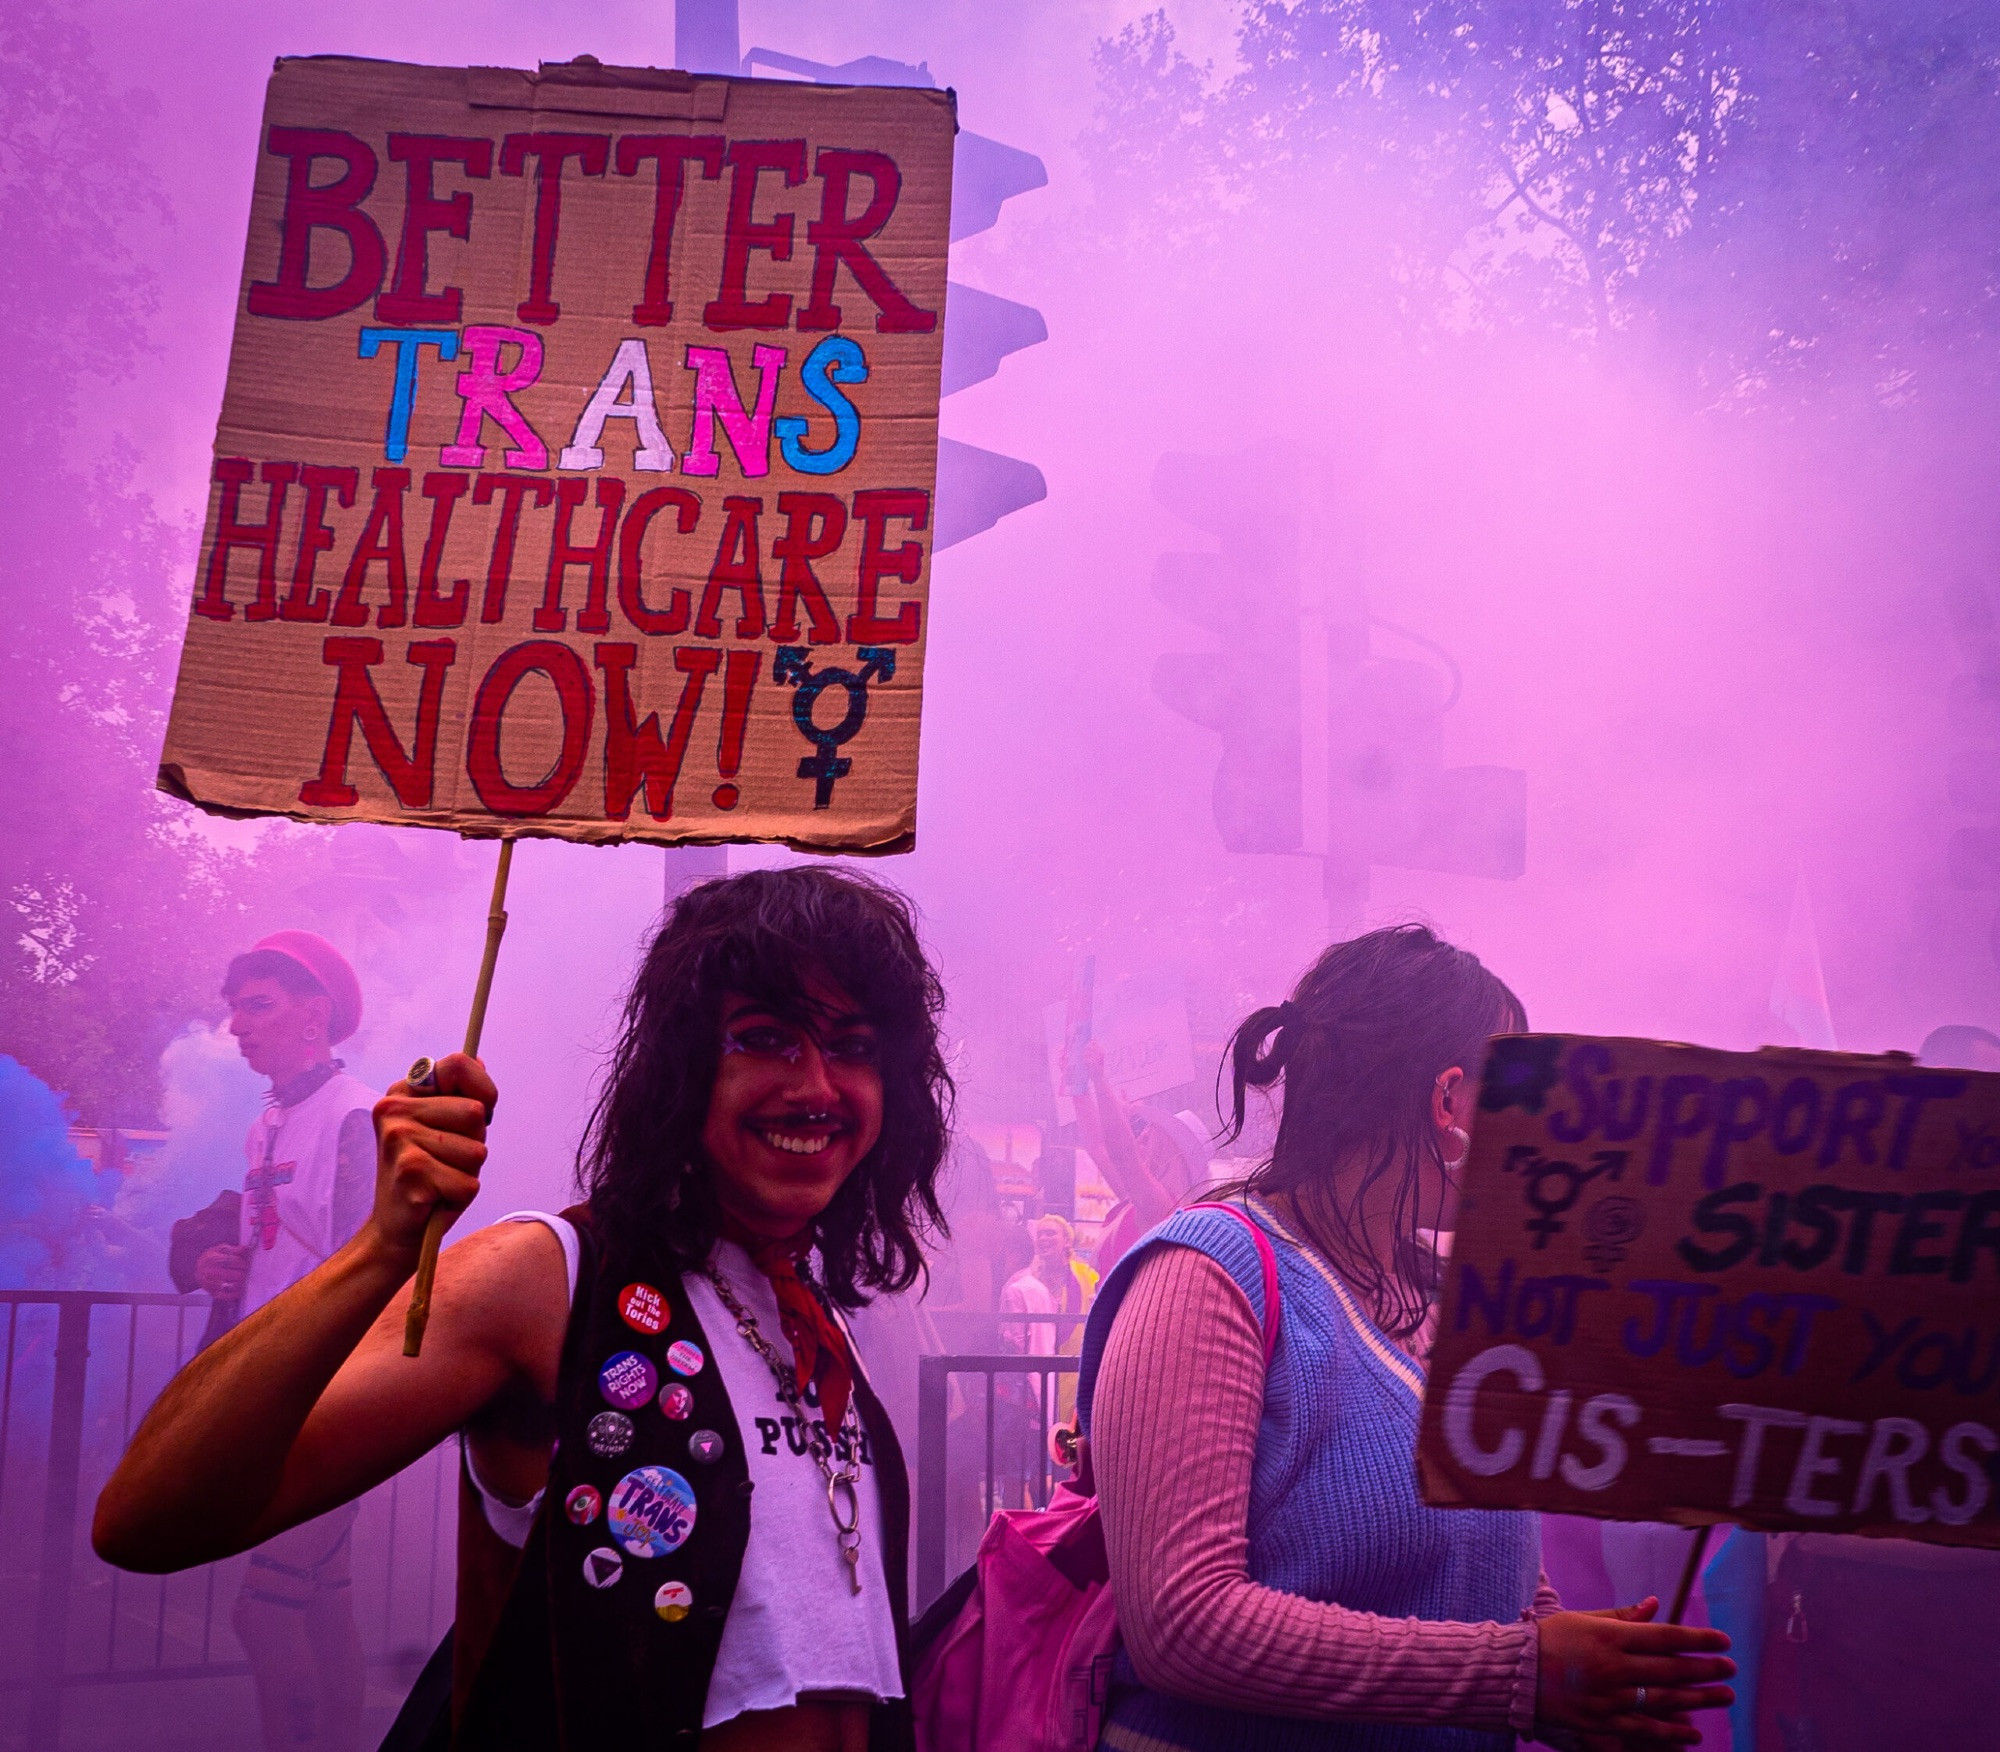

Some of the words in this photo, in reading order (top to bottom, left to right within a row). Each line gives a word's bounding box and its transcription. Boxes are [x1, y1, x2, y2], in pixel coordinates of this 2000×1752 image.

[247, 125, 937, 333] BETTER
[358, 324, 870, 478] TRANS
[194, 457, 930, 645] HEALTHCARE
[299, 637, 761, 822] NOW!
[1548, 1043, 1968, 1188] SUPPORT
[625, 1303, 659, 1330] Tories
[630, 1297, 645, 1309] out
[647, 1304, 661, 1318] the
[635, 1285, 660, 1307] Kick
[1454, 1259, 1609, 1346] NOT
[1621, 1277, 1841, 1380] JUST
[602, 1354, 638, 1381] TRANS
[608, 1363, 646, 1393] RIGHTS
[619, 1376, 647, 1399] NOW
[619, 1476, 688, 1544] TRANS
